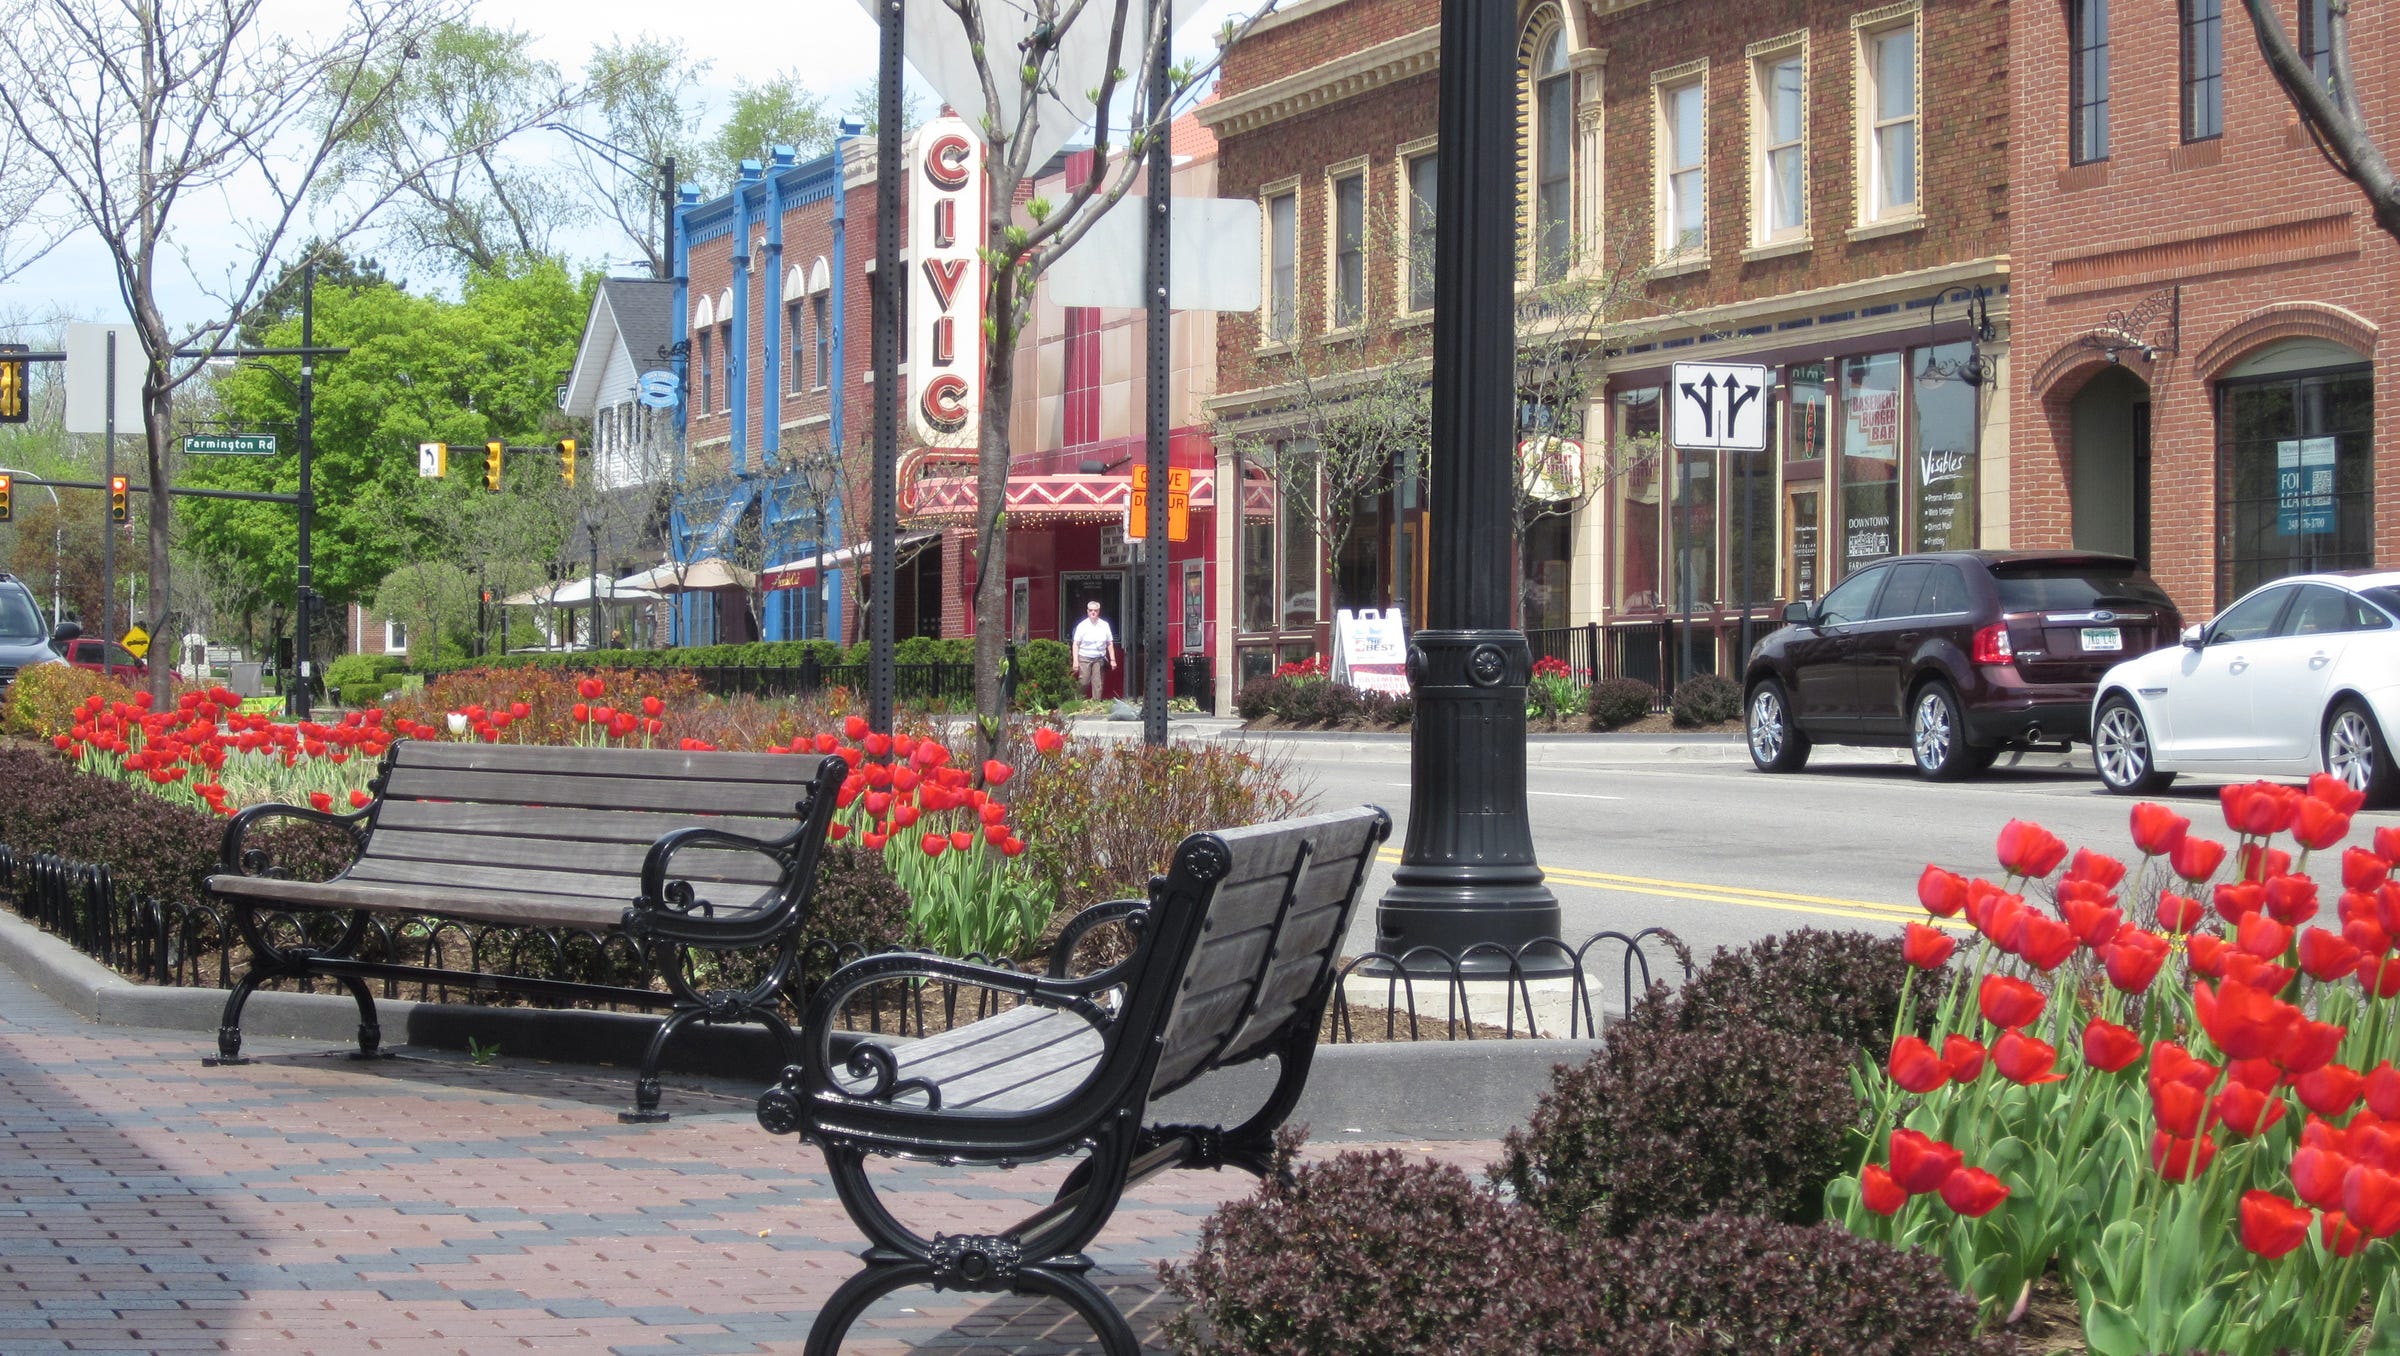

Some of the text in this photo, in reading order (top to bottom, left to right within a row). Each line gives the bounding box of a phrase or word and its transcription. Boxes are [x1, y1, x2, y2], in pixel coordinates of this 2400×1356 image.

[922, 133, 970, 432] CIVIC
[1852, 391, 1896, 412] BASEMENT
[1862, 409, 1896, 427] BURGER
[1871, 426, 1896, 440] BAR
[187, 438, 273, 451] Farmington Rd
[1921, 448, 1963, 486] Visibles
[1140, 470, 1182, 487] GVE
[2281, 472, 2300, 490] FO
[1134, 495, 1184, 510] DUR
[2281, 491, 2311, 509] LEAE
[1848, 516, 1889, 529] DOWNTOWN
[1366, 644, 1395, 652] BEST
